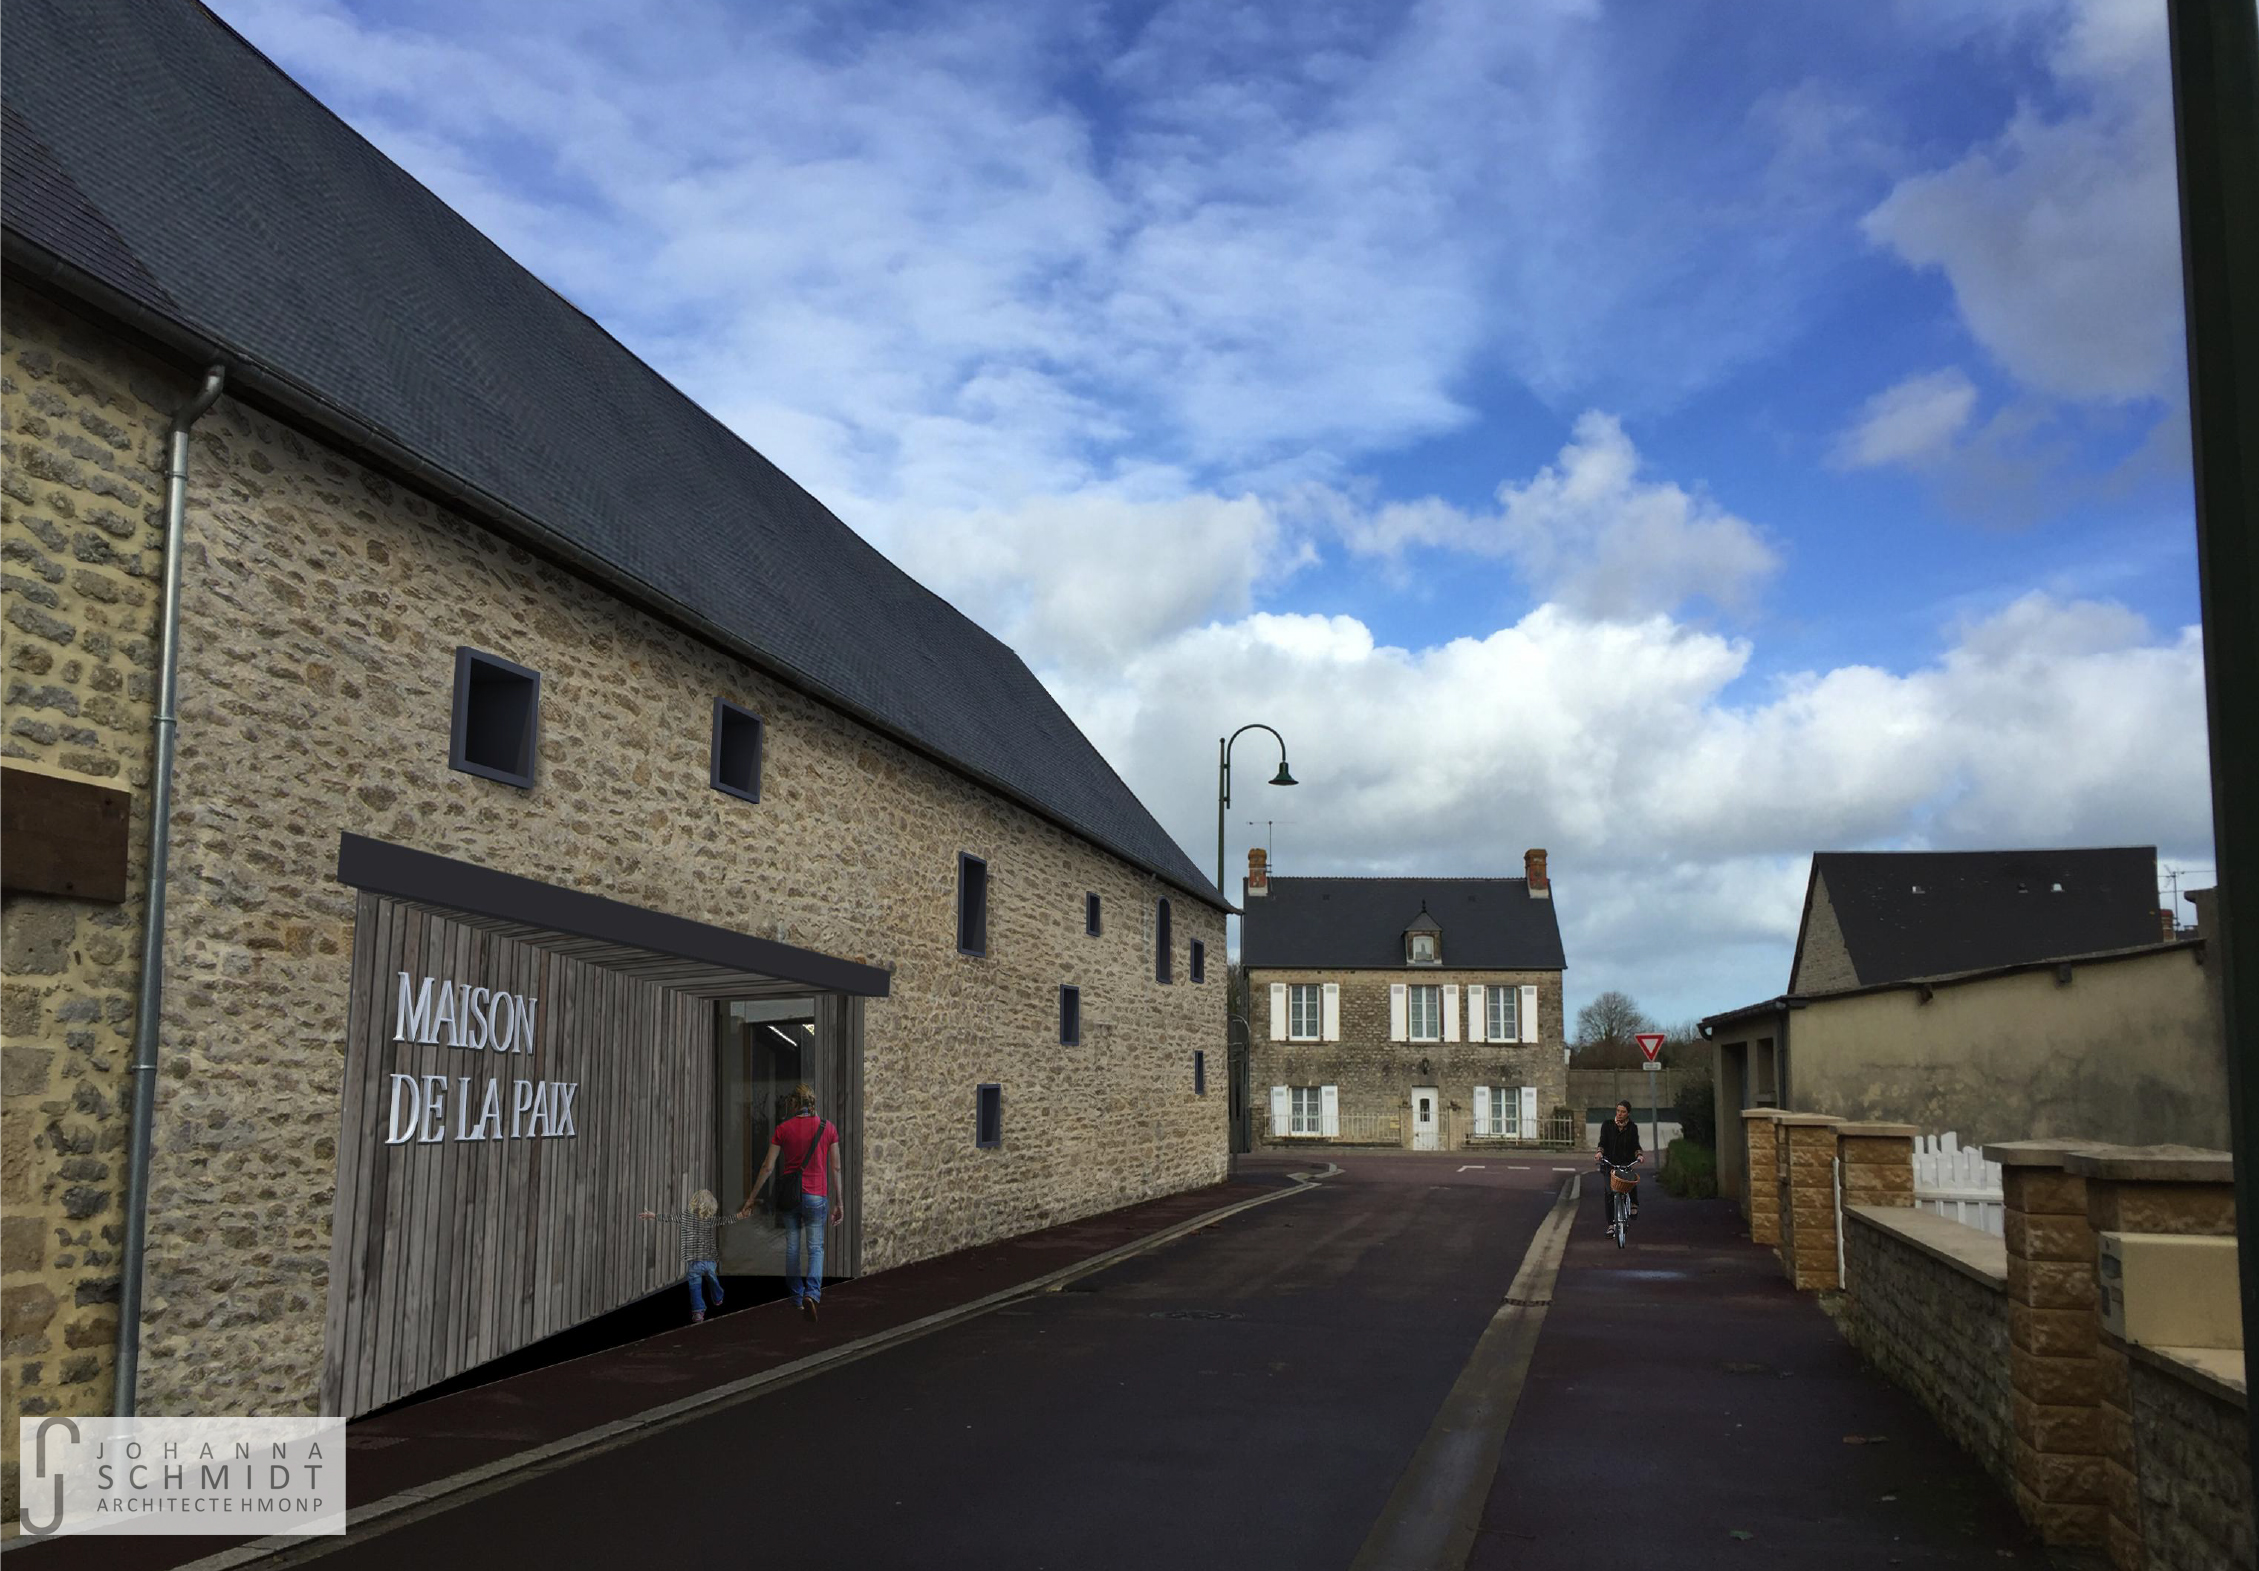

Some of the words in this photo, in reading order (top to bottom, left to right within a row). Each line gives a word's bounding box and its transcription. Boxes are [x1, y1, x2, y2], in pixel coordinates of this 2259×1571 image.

[393, 971, 538, 1054] MAISON
[385, 1073, 448, 1144] DE
[454, 1077, 503, 1141] LA
[511, 1079, 578, 1139] PAIX
